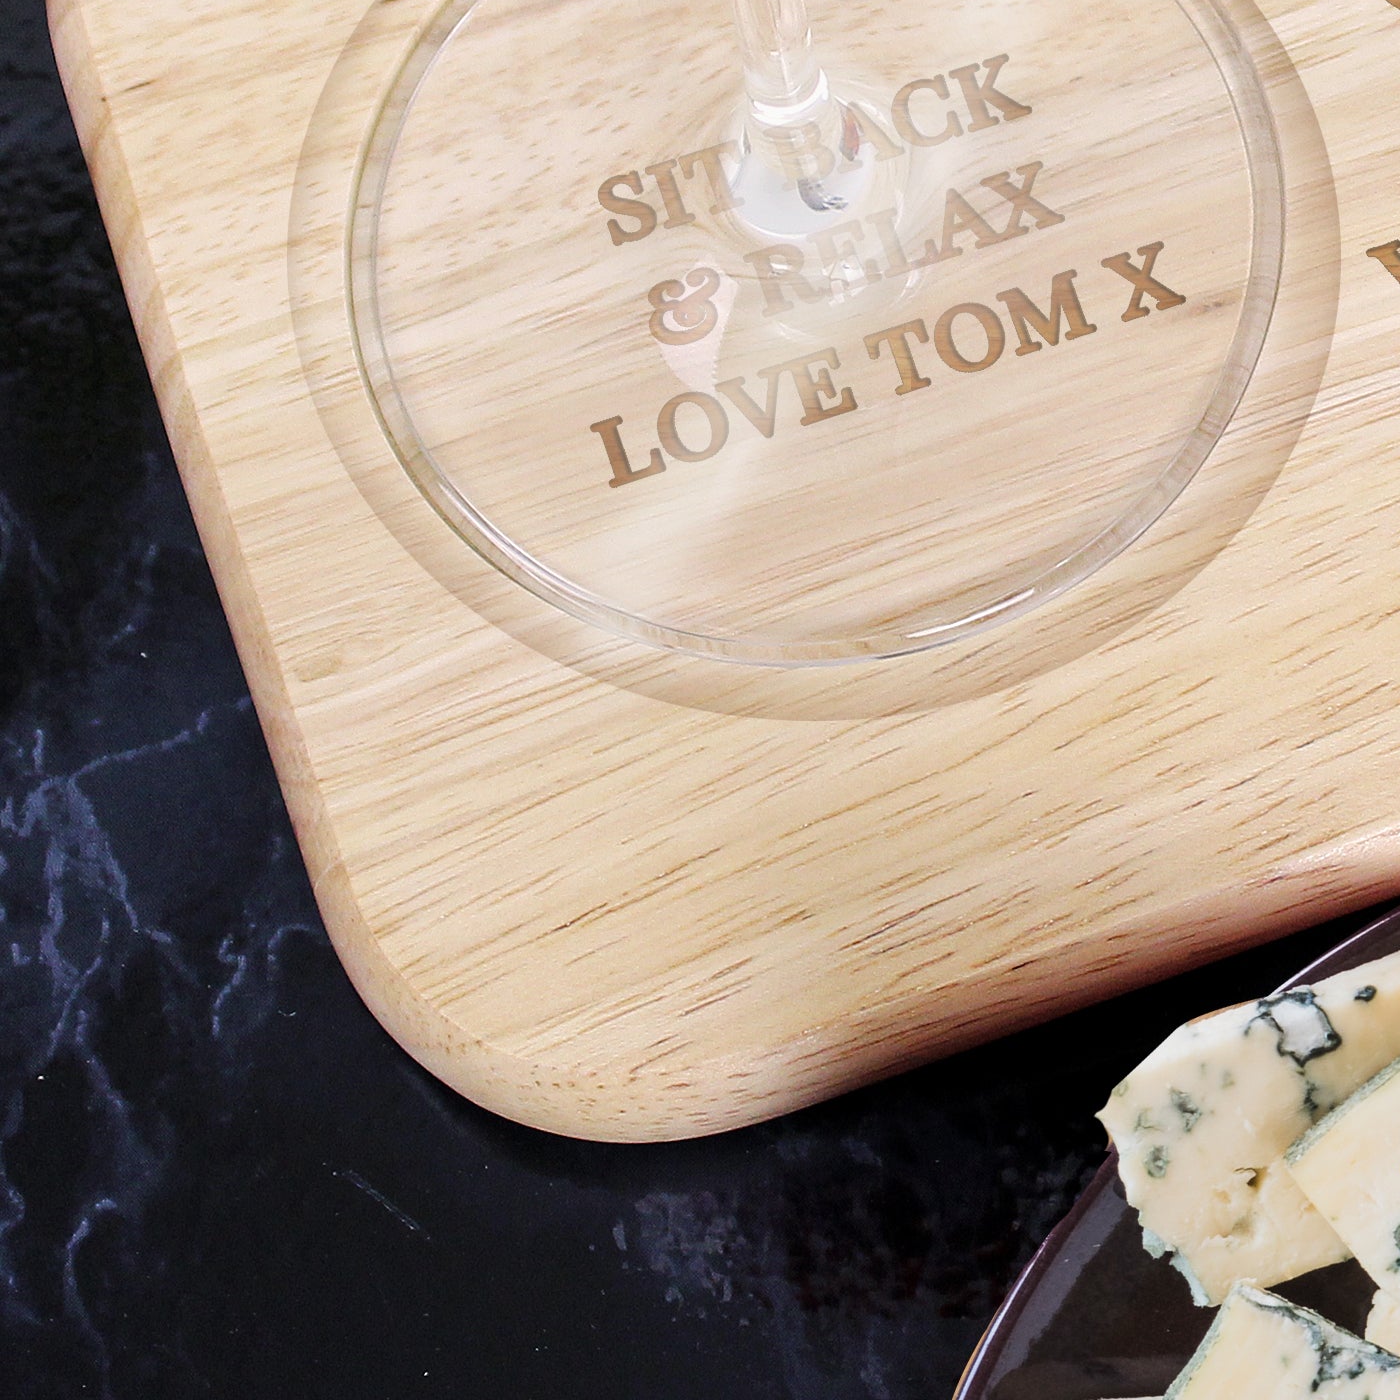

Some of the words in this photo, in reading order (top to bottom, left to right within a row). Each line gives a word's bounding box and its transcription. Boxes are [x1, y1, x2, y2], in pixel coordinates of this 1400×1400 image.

[597, 140, 746, 246] SIT
[762, 53, 1033, 192] BACK
[648, 266, 721, 345] &
[743, 160, 1065, 318] RELAX
[590, 346, 859, 489] LOVE
[864, 269, 1098, 396] TOM
[1101, 240, 1187, 322] X
